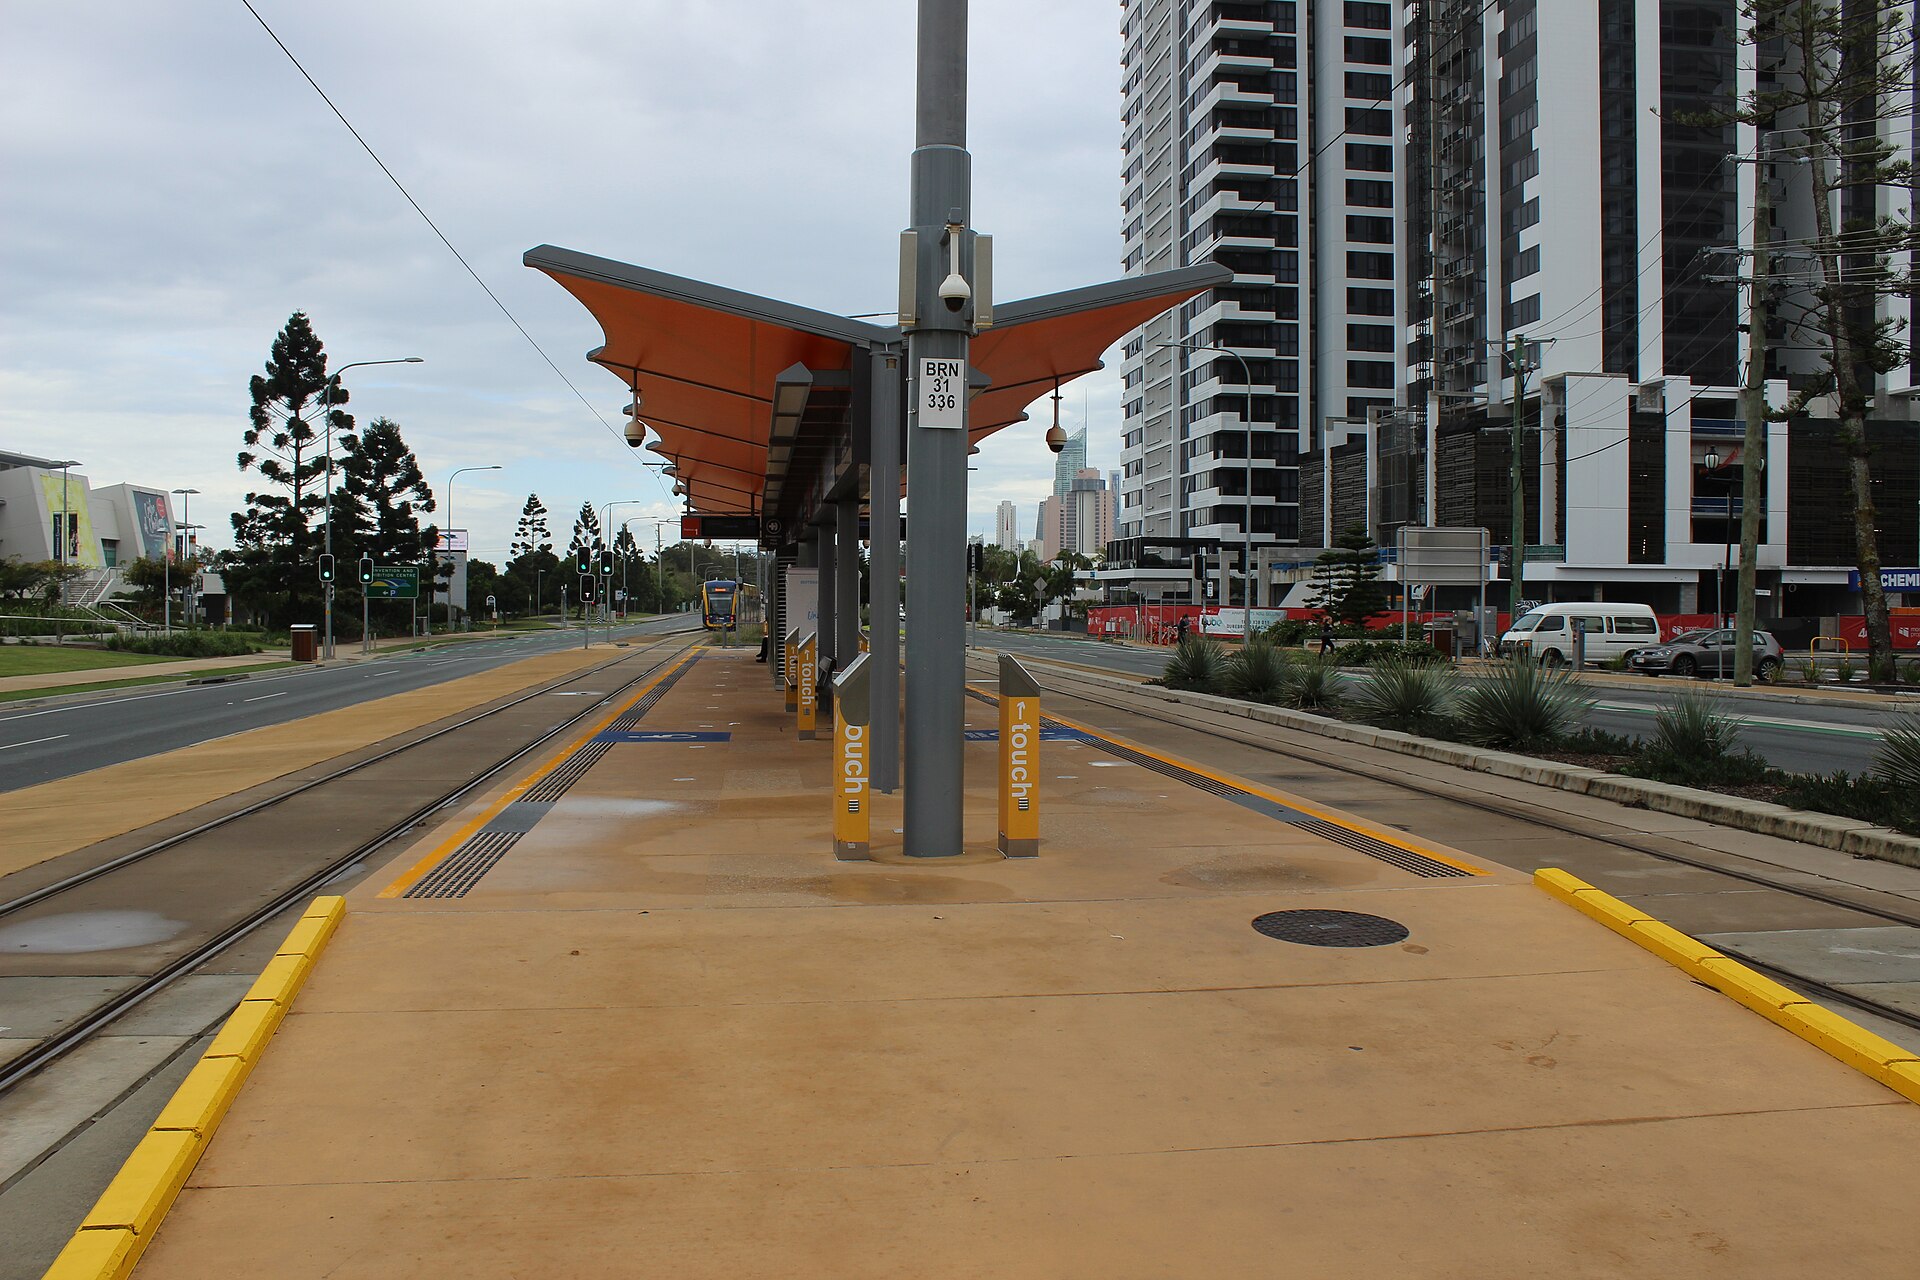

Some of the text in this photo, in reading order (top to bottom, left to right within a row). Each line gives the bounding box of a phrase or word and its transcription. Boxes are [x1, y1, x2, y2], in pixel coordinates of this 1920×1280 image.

[926, 362, 959, 377] BRN
[933, 378, 950, 393] 31
[928, 394, 956, 409] 336
[788, 655, 798, 680] touc
[801, 662, 815, 705] touch
[844, 724, 869, 794] ouch
[1011, 722, 1033, 798] touch
